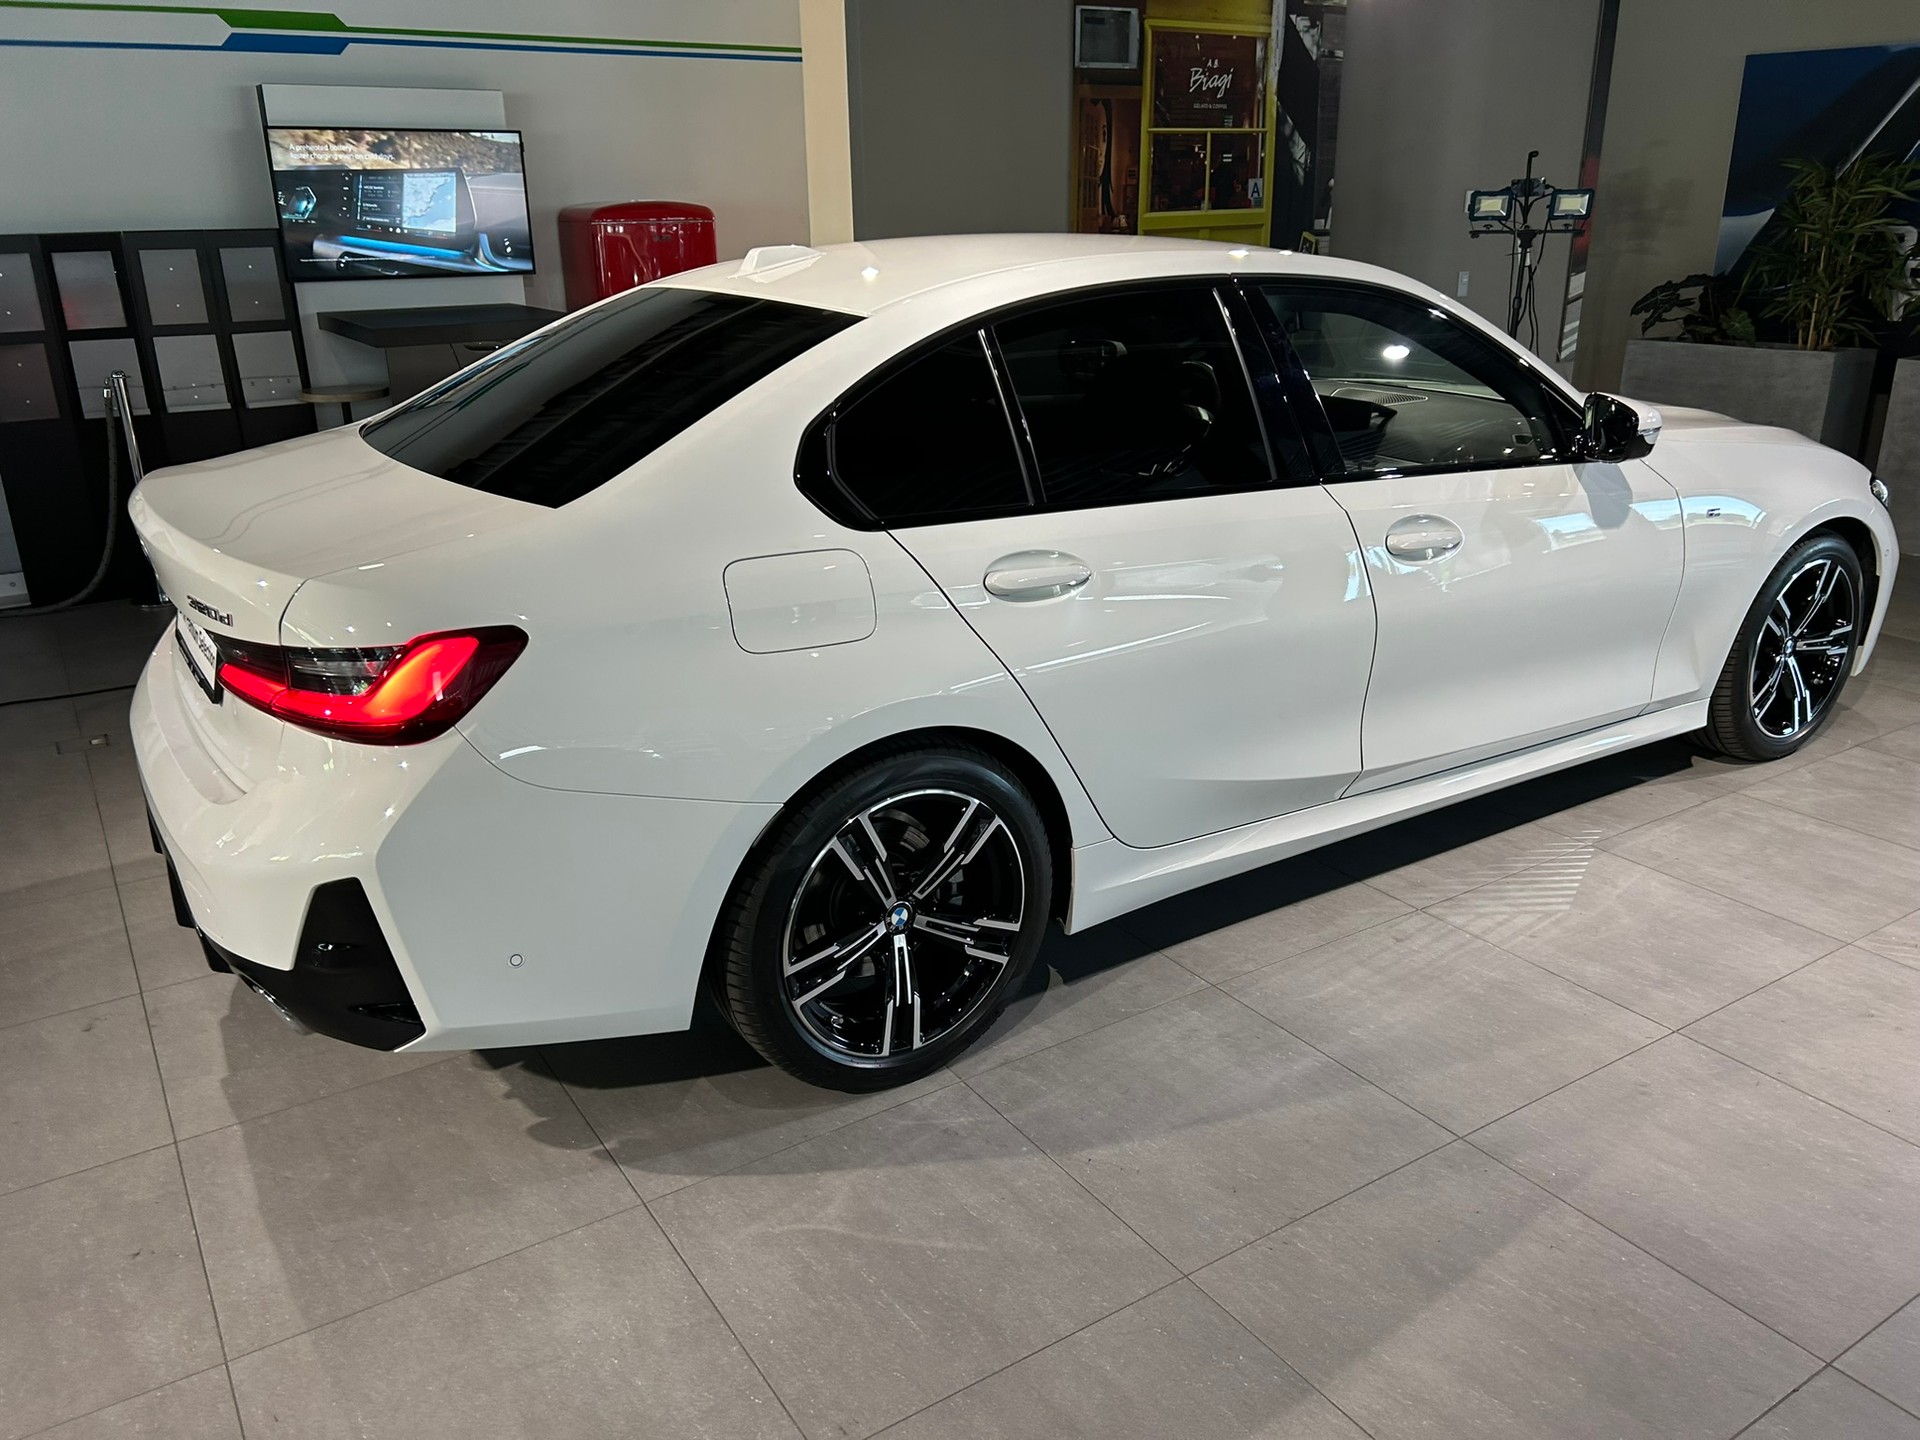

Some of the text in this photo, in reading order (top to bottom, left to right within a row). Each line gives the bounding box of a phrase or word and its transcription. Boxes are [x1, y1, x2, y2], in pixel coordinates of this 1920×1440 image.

[1189, 67, 1234, 98] Biagi
[289, 143, 295, 151] A
[310, 152, 338, 161] charging
[1250, 182, 1260, 198] A
